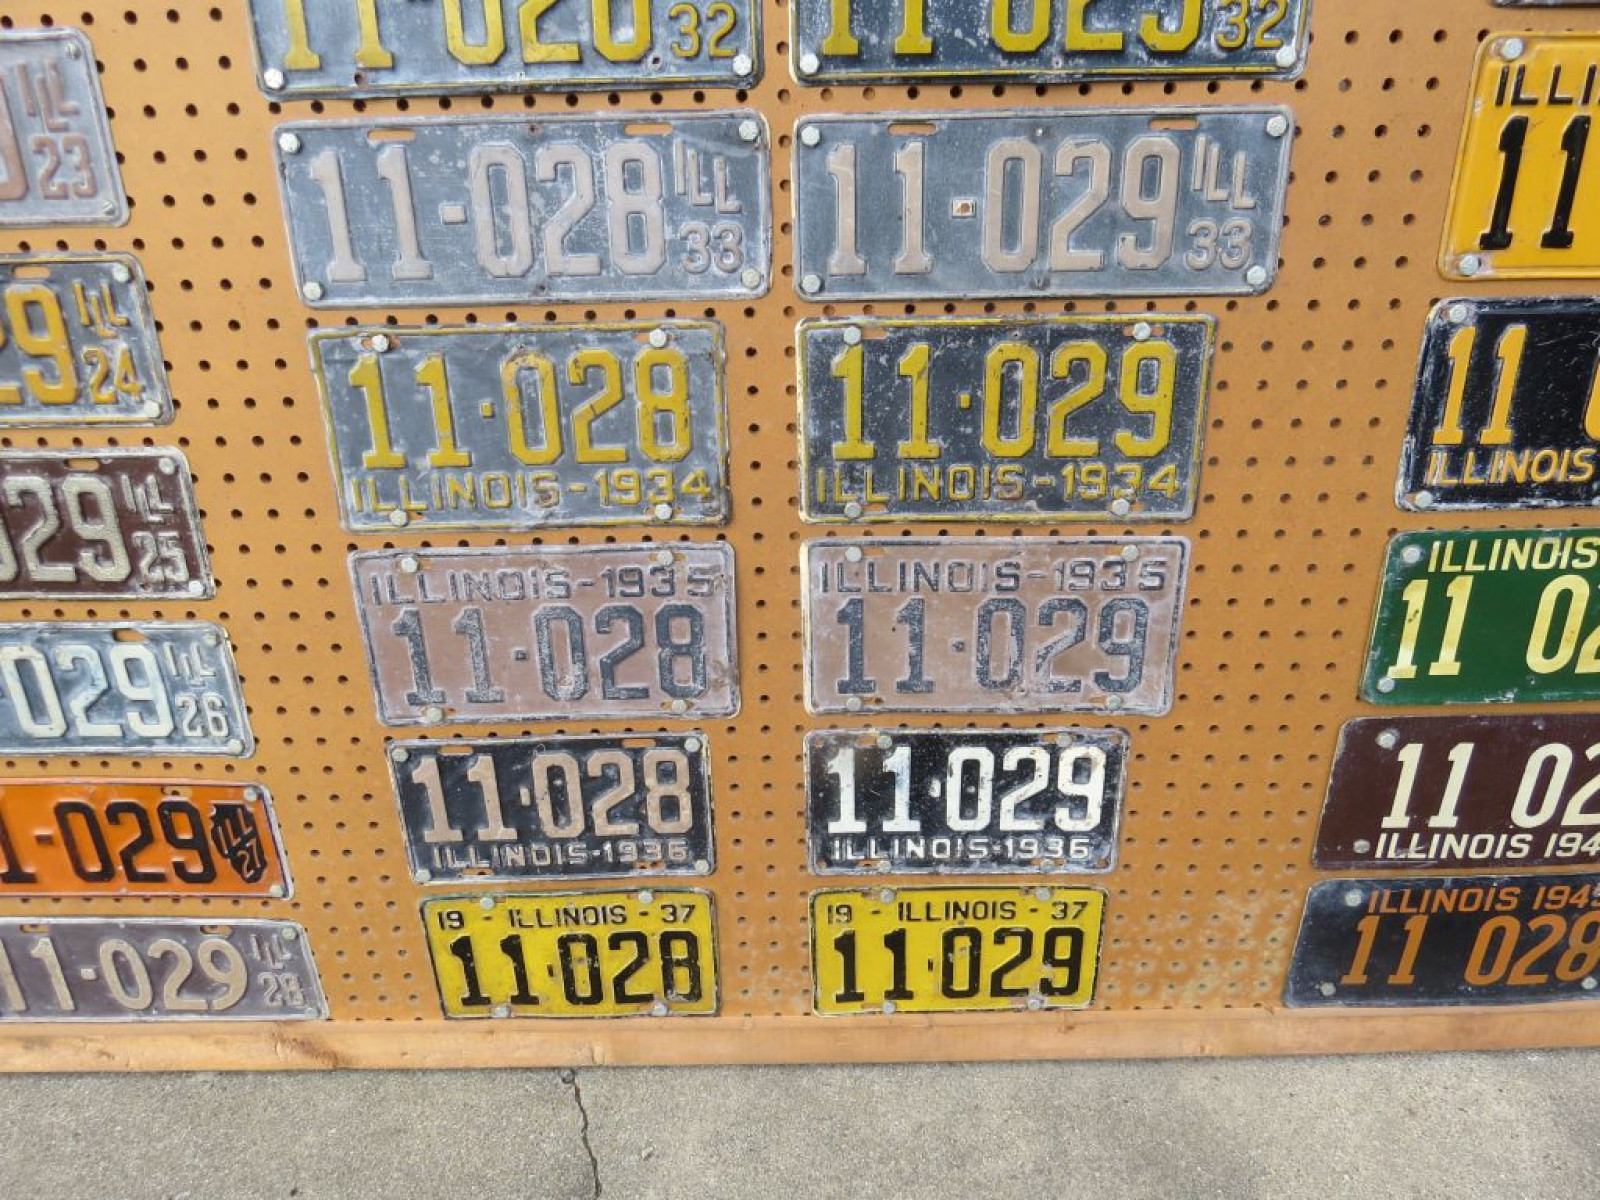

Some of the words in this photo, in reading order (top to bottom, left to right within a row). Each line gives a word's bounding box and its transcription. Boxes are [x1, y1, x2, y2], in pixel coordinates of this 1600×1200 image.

[669, 2, 737, 58] 32
[1216, 0, 1287, 48] 32
[16, 60, 80, 132] ILL
[1495, 64, 1600, 106] ILLI
[32, 135, 96, 200] 23
[673, 139, 742, 213] ILL
[1192, 135, 1257, 209] ILL
[1479, 115, 1591, 250] 11
[679, 222, 744, 274] 33
[1186, 217, 1252, 270] 33
[73, 280, 130, 339] ILL
[82, 345, 143, 405] 24
[1432, 325, 1527, 445] 11
[350, 469, 711, 514] ILLINOIS-1934
[817, 463, 1180, 503] ILLINOIS-1934
[1425, 448, 1597, 486] ILLINOIS
[120, 474, 175, 523] ILL
[132, 531, 190, 583] 25
[1427, 536, 1600, 573] ILLINOIS
[1386, 574, 1475, 679] 11
[163, 642, 216, 688] ILL
[175, 693, 229, 737] 26
[1381, 743, 1475, 829] 11
[1374, 833, 1533, 859] ILLINOIS
[437, 911, 465, 930] 19
[509, 905, 628, 929] ILLINOIS
[661, 904, 696, 924] 37
[826, 904, 853, 924] 19
[898, 901, 1017, 922] ILLINOIS
[1051, 901, 1089, 921] 37
[1368, 886, 1521, 914] ILLINOIS
[1532, 884, 1600, 910] 194
[1341, 914, 1429, 985] 11
[1464, 910, 1600, 985] 028
